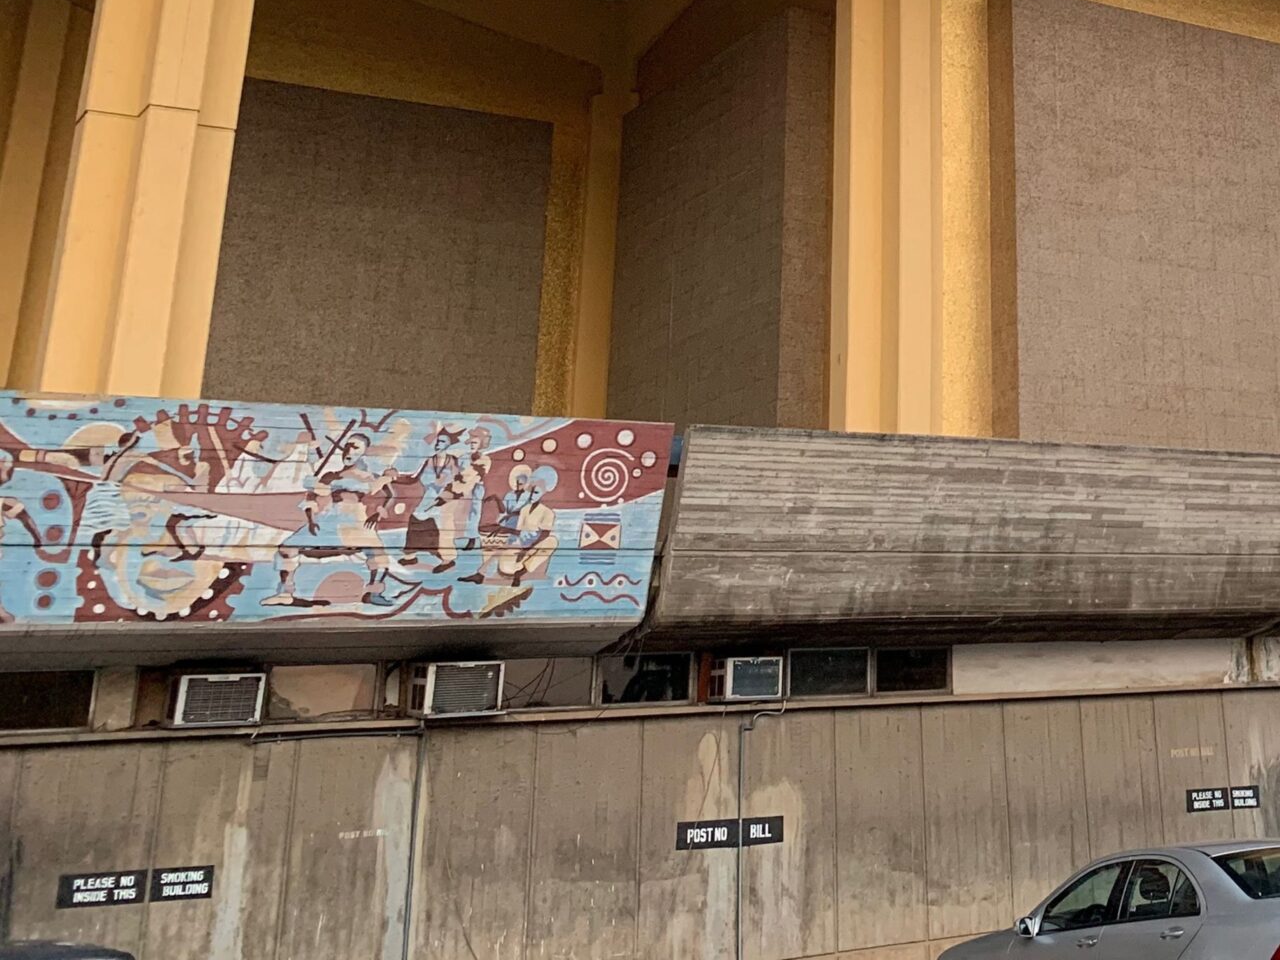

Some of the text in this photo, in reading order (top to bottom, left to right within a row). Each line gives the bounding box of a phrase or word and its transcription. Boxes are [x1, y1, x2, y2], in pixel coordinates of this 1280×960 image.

[1191, 791, 1213, 800] PLEASE
[687, 823, 772, 844] POST NO BILL
[73, 871, 204, 890] PLEASE NO SMOKING
[72, 883, 209, 903] INSIDE THIS BUILDING
